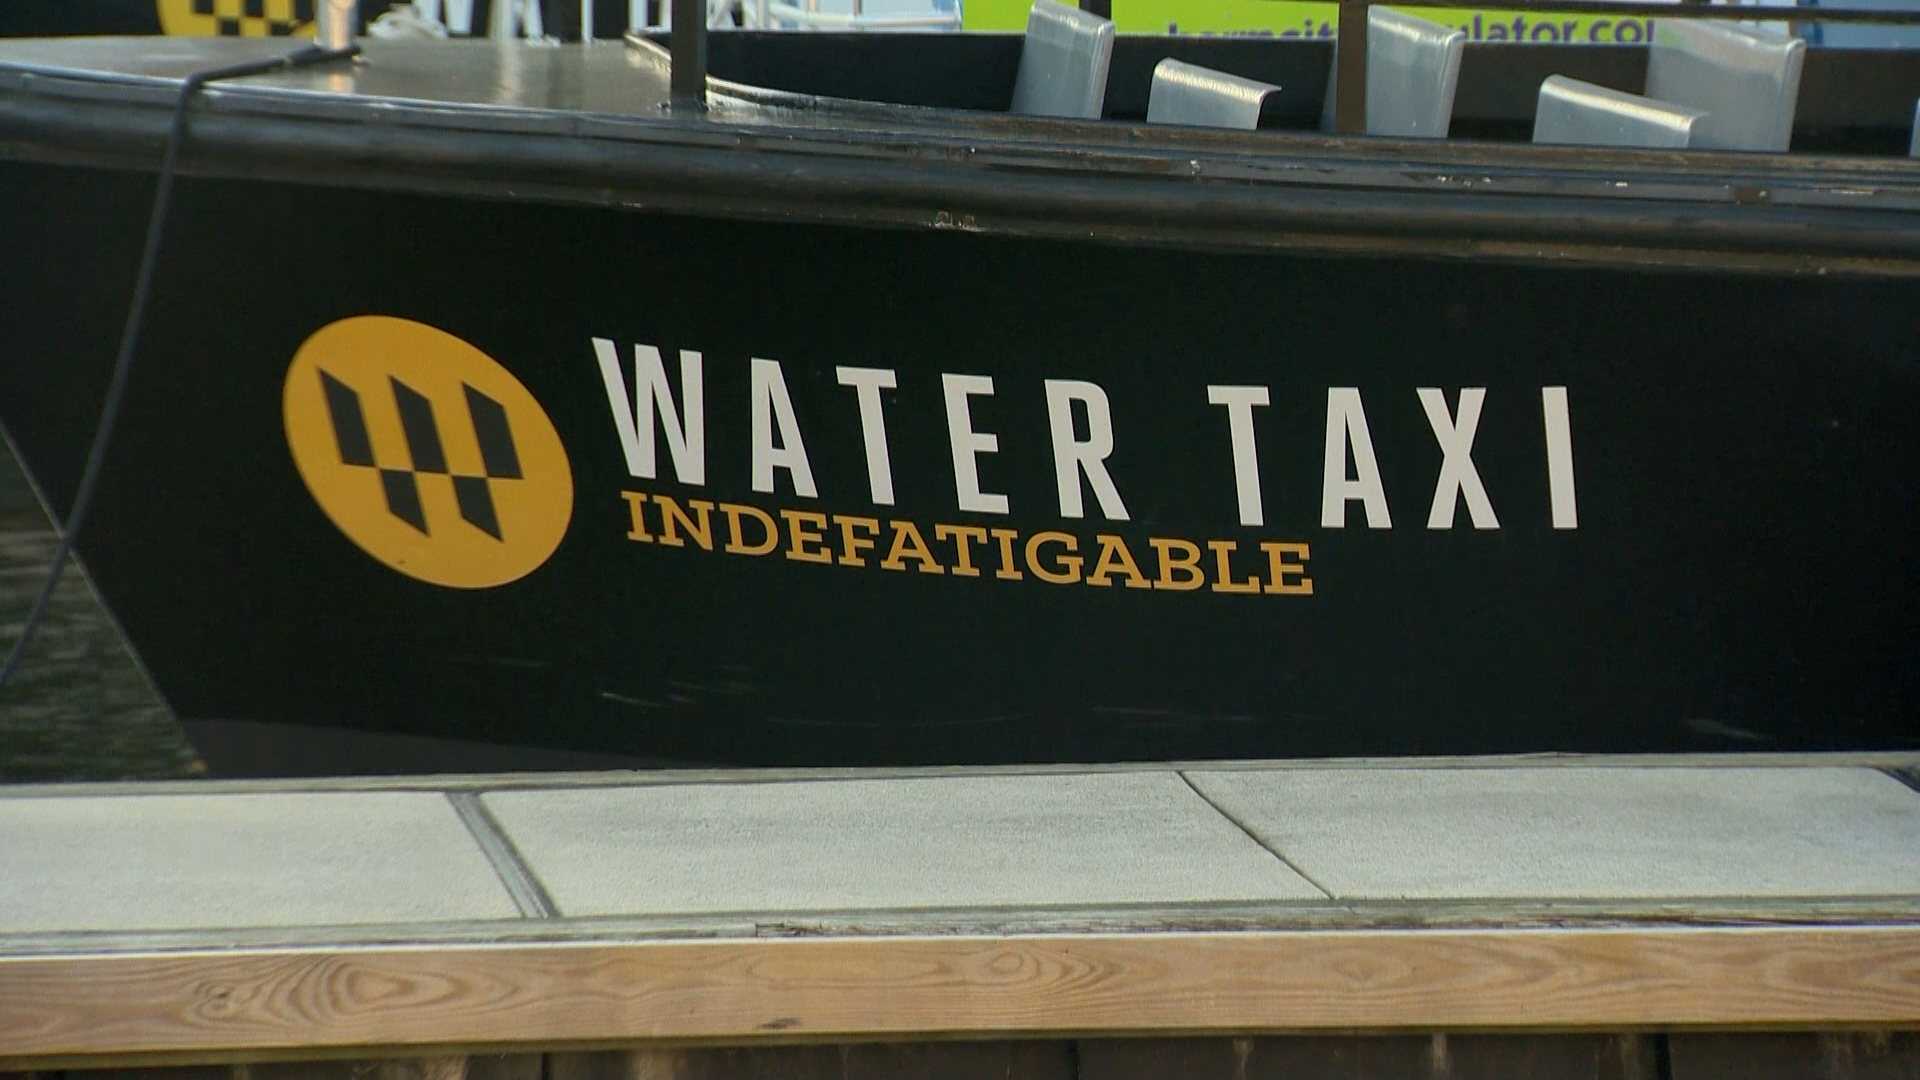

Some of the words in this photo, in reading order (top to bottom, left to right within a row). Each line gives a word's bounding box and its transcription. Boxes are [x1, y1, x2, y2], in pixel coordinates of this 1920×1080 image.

[591, 337, 1131, 521] WATER
[1207, 385, 1578, 529] TAXI
[621, 490, 1314, 594] INDEFATIGABLE
